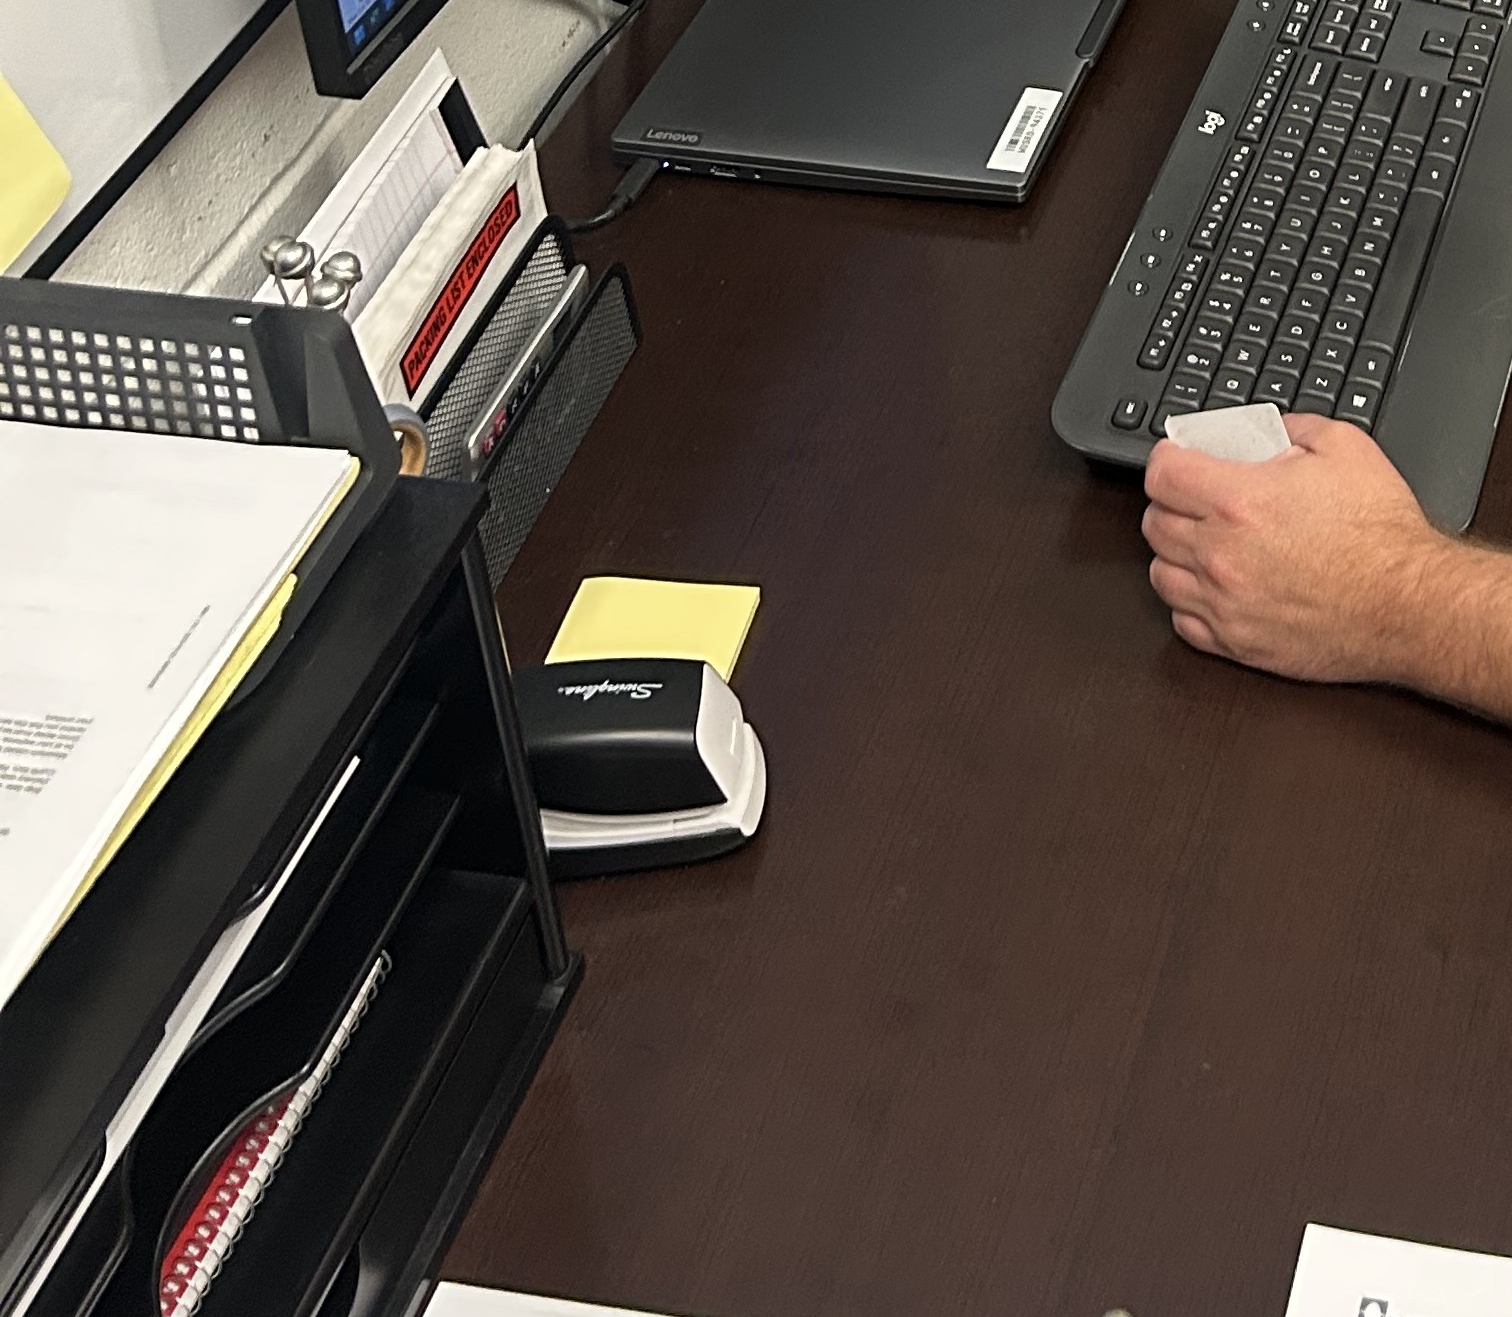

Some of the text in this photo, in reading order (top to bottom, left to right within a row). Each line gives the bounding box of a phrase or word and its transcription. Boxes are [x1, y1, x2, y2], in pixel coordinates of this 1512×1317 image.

[1198, 109, 1226, 135] logi
[646, 128, 699, 144] Lenovo
[1317, 146, 1328, 154] P
[1309, 169, 1320, 179] O
[1339, 196, 1351, 205] K
[1290, 218, 1302, 227] U
[1331, 221, 1342, 229] J
[1280, 243, 1291, 251] Y
[1321, 246, 1333, 255] H
[1363, 242, 1375, 251] N
[1311, 272, 1323, 281] G
[1354, 268, 1366, 277] B
[407, 199, 514, 381] PACKING LIST ENCLOSED
[1259, 296, 1272, 305] R
[1345, 294, 1356, 302] V
[1301, 299, 1312, 307] F
[1248, 323, 1261, 332] E
[1290, 325, 1303, 335] D
[1335, 321, 1348, 330] C
[1237, 349, 1250, 361] W
[1326, 348, 1338, 358] X
[1280, 354, 1293, 363] S
[1226, 379, 1239, 390] Q
[1315, 377, 1329, 387] Z
[1270, 383, 1282, 392] A
[562, 679, 663, 702] Swingline
